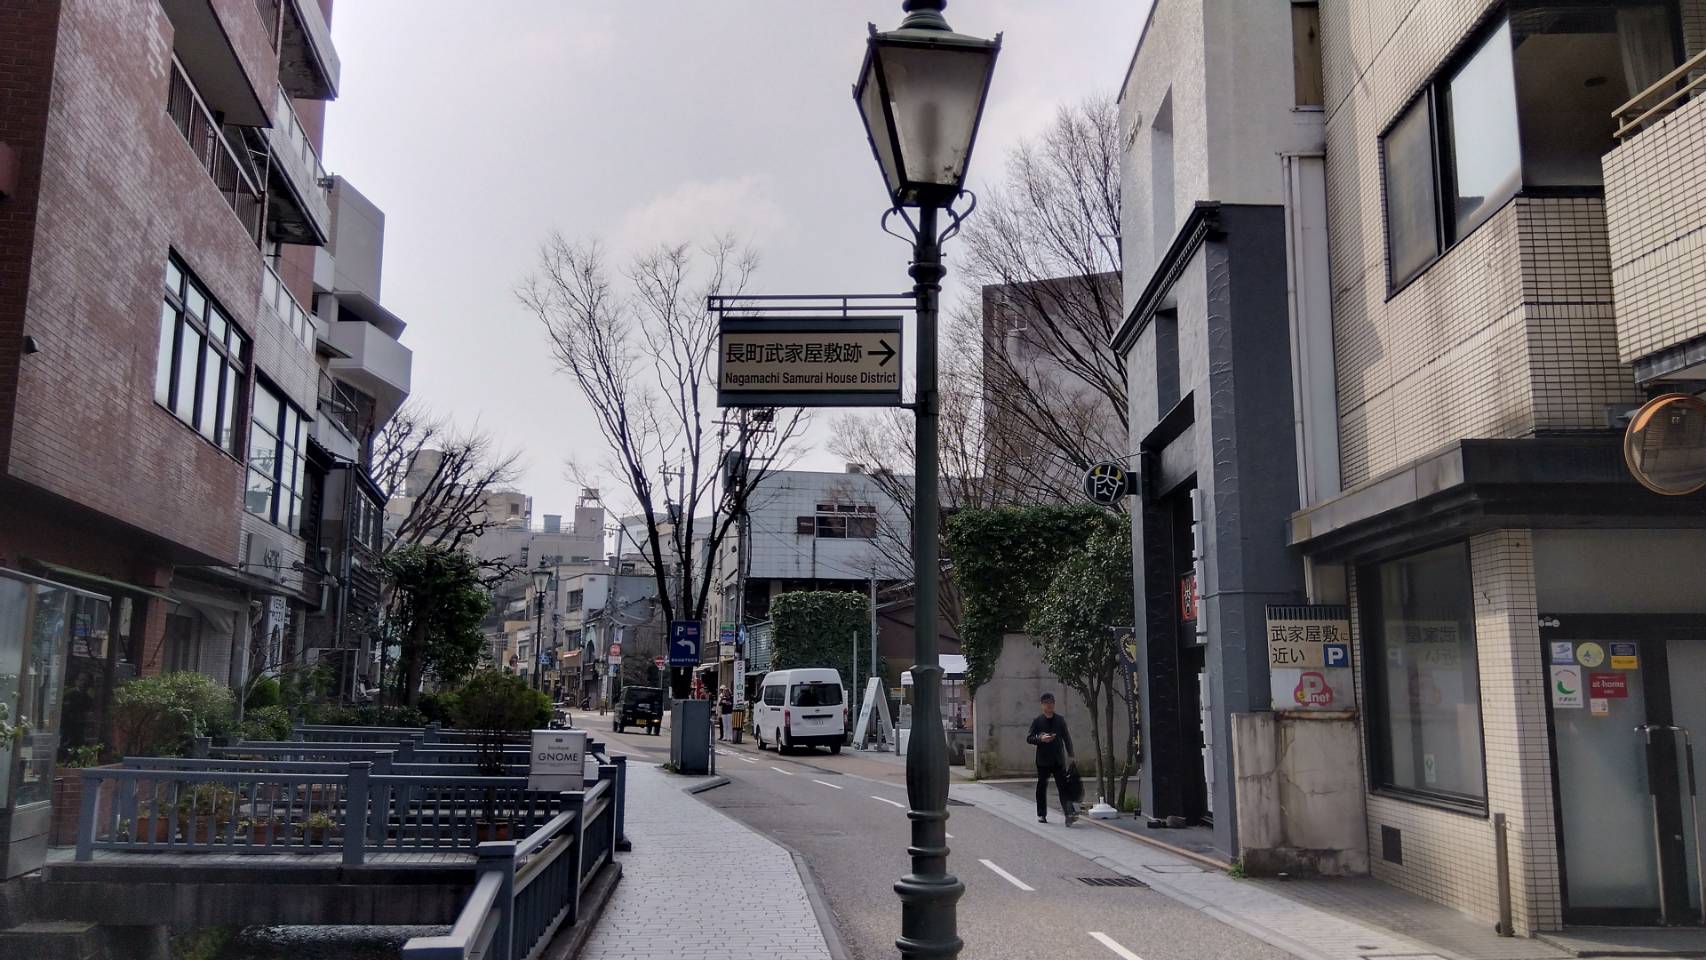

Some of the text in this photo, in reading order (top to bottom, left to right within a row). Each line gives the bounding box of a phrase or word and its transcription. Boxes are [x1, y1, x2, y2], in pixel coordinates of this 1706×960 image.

[725, 343, 862, 364] 長町武家屋敷跡
[725, 372, 896, 386] Nagamachi Samurai House District
[677, 626, 684, 636] P
[1271, 624, 1349, 642] 武家屋敷に
[1272, 647, 1305, 664] 近い
[1327, 647, 1344, 665] P
[538, 752, 578, 762] GNOME
